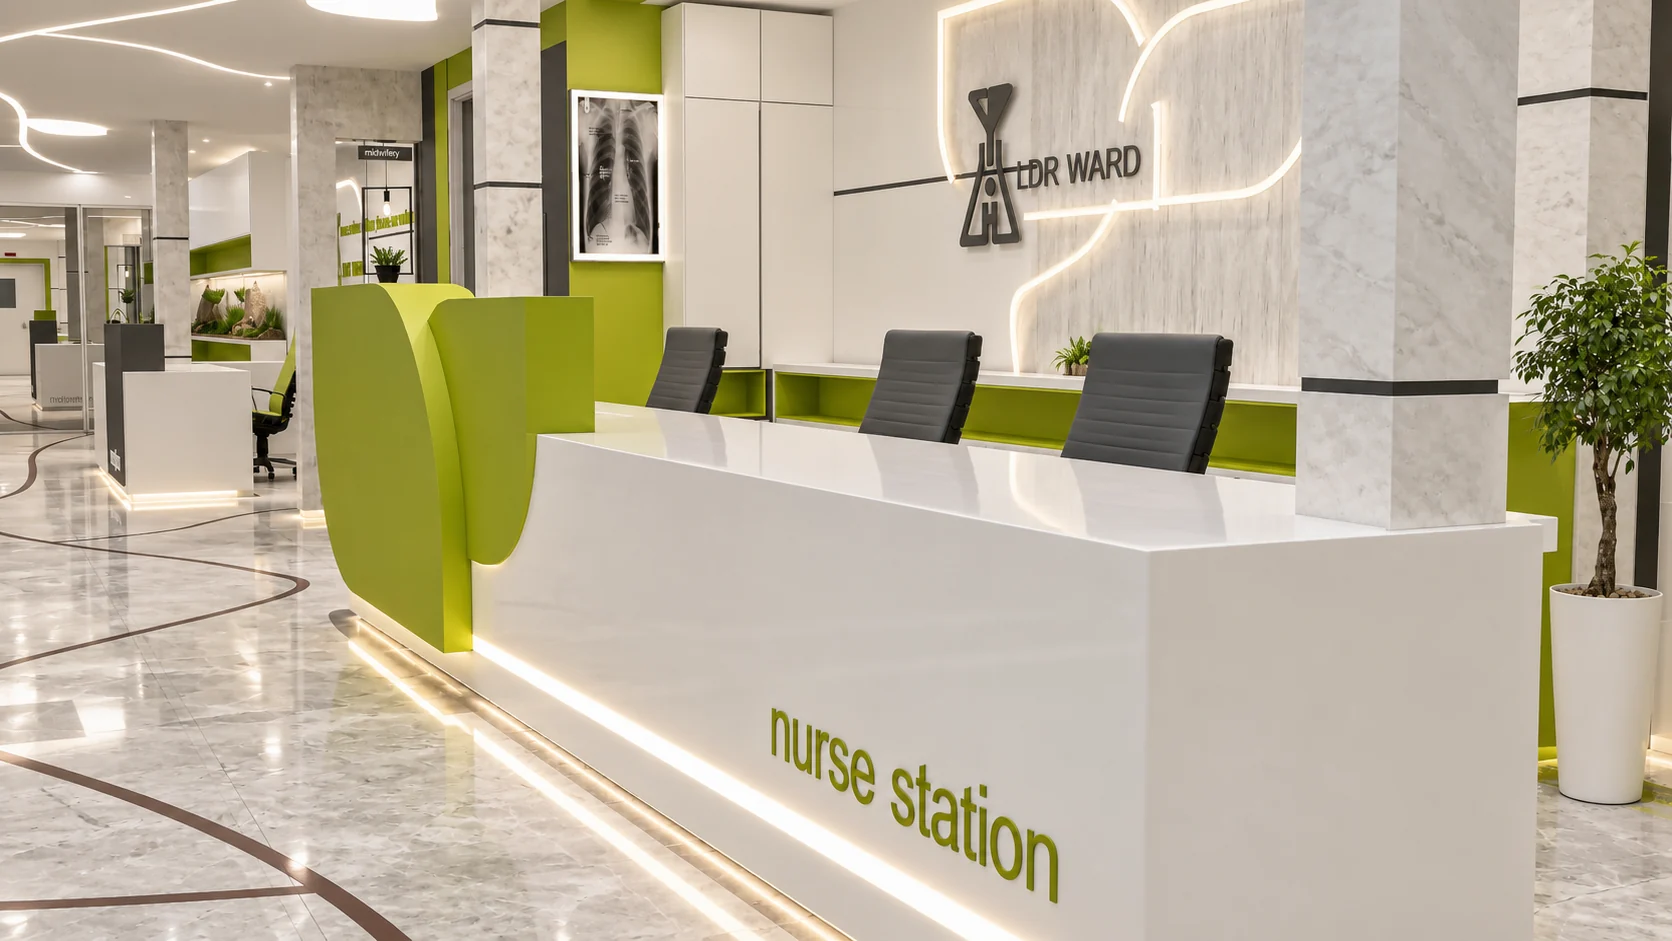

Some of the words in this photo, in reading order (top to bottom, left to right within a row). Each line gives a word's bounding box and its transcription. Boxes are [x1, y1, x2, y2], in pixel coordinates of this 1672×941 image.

[1017, 156, 1059, 190] LDR
[1066, 145, 1141, 184] WARD
[771, 707, 875, 805] nurse
[890, 764, 1058, 904] station
